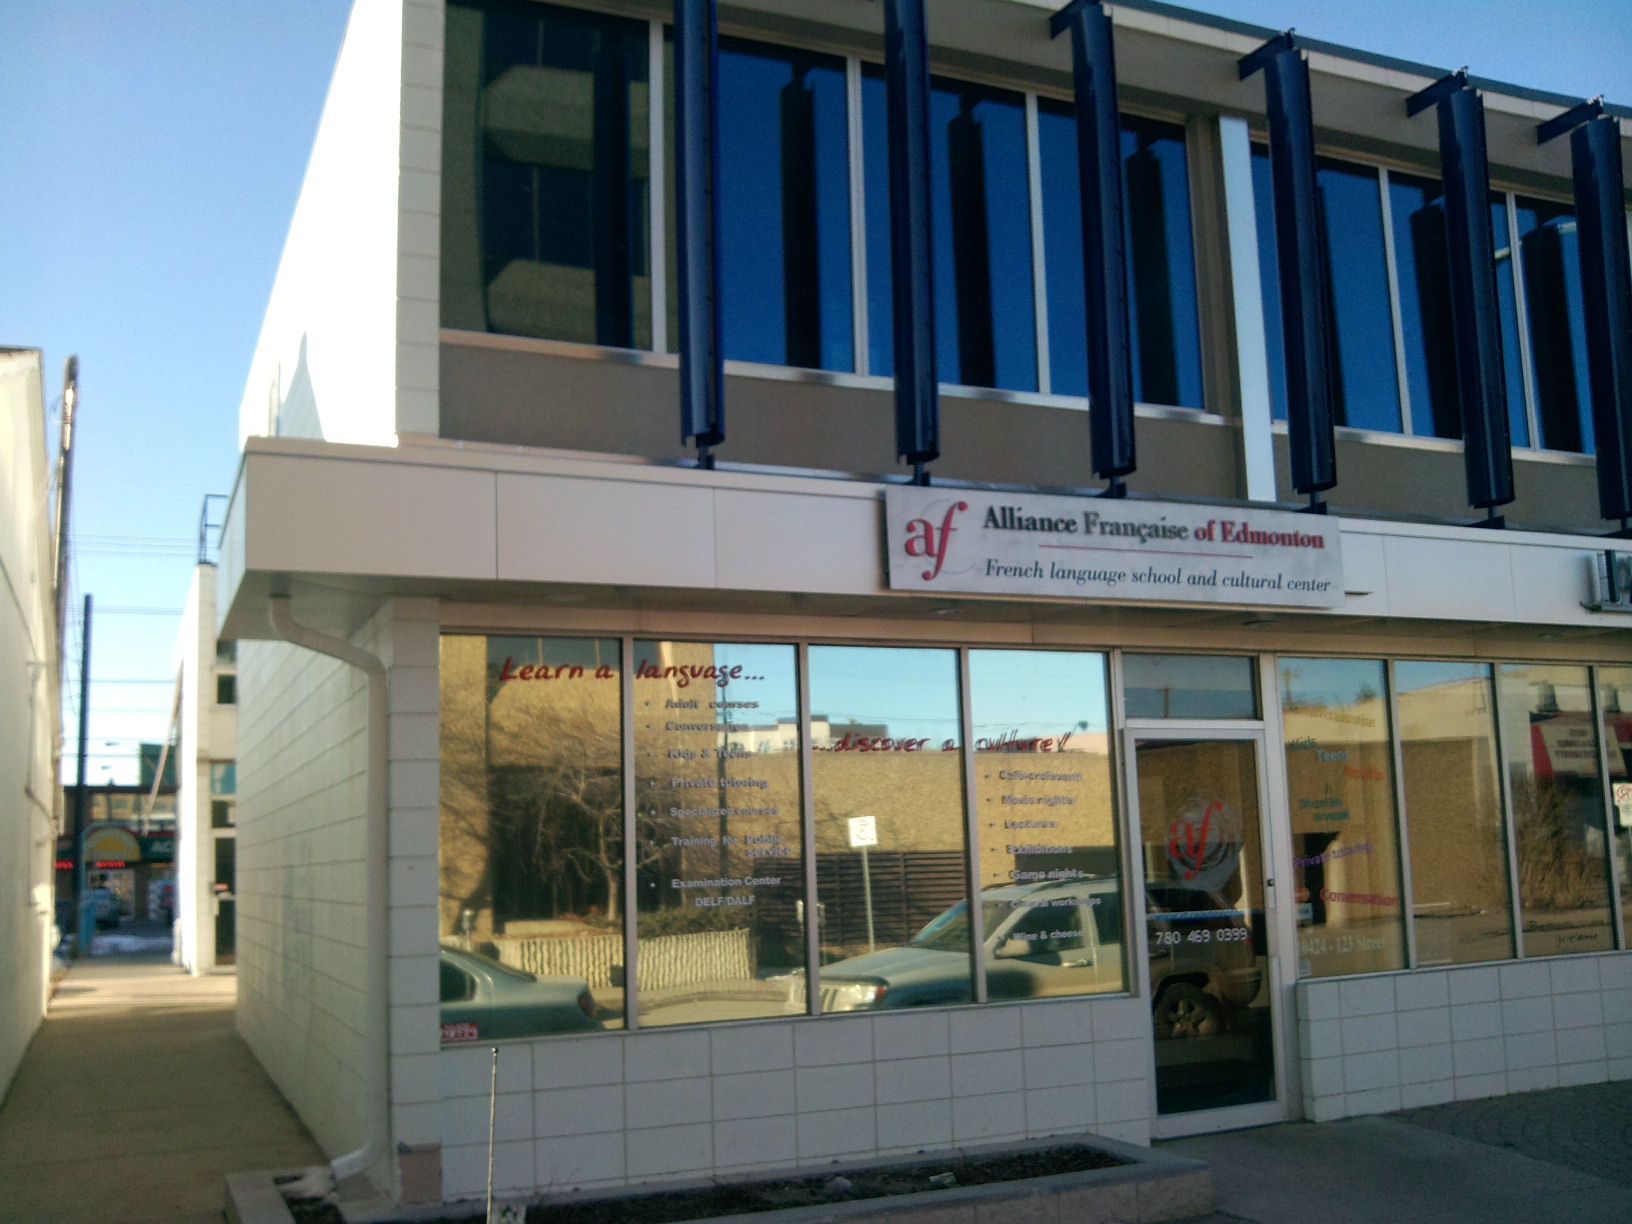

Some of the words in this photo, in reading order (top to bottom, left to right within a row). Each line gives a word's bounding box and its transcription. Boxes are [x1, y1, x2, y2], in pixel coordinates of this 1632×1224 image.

[983, 506, 1077, 534] Alliance
[1084, 512, 1188, 543] Française
[1195, 519, 1219, 542] of
[1221, 521, 1325, 549] Edmonton
[985, 559, 1044, 579] French
[1050, 562, 1126, 587] language
[1131, 566, 1181, 585] school
[1187, 569, 1217, 587] and
[1222, 572, 1282, 590] cultural
[1287, 576, 1331, 592] center
[499, 656, 584, 681] Learn
[595, 664, 613, 680] a
[709, 700, 759, 709] courses
[671, 836, 717, 848] Training
[1010, 870, 1045, 881] Game
[1048, 868, 1084, 880] nights
[671, 878, 742, 889] Examination
[744, 876, 782, 886] Center
[1040, 930, 1048, 939] &
[1155, 931, 1181, 945] 780
[1187, 929, 1211, 943] 469
[1216, 927, 1248, 941] 0399
